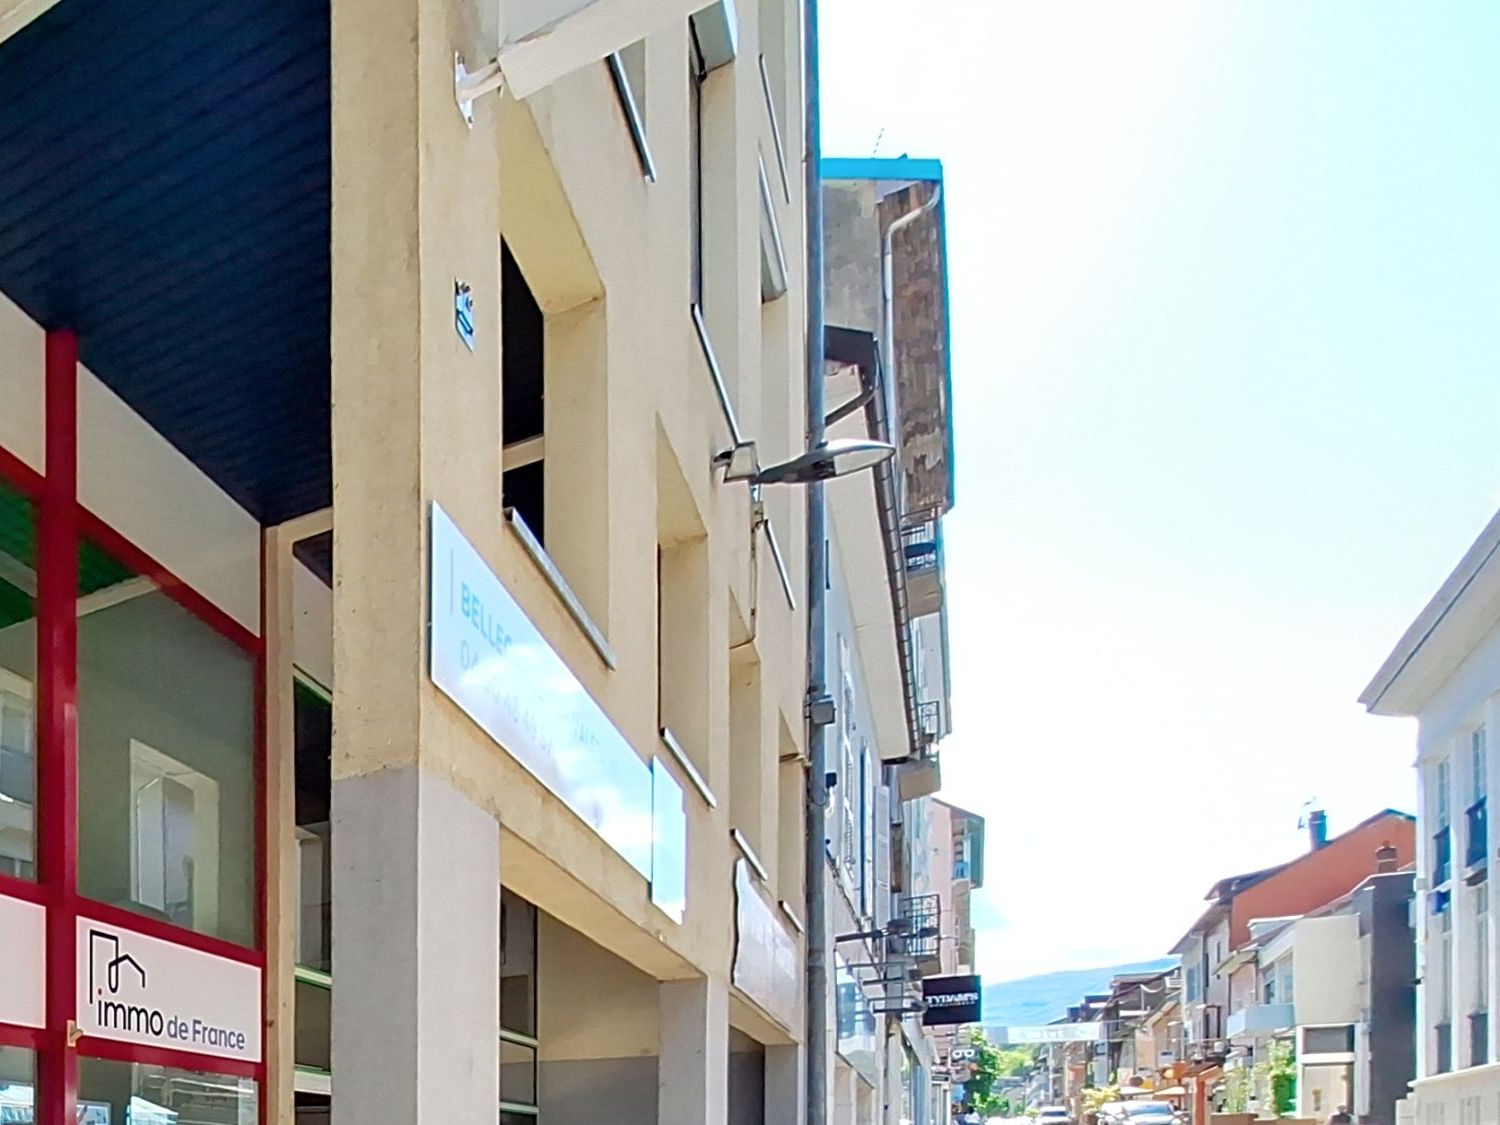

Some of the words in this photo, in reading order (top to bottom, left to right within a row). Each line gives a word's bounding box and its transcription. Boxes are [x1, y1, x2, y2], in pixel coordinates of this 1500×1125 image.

[97, 988, 164, 1037] immo
[166, 1015, 189, 1041] de
[192, 1019, 246, 1050] France
